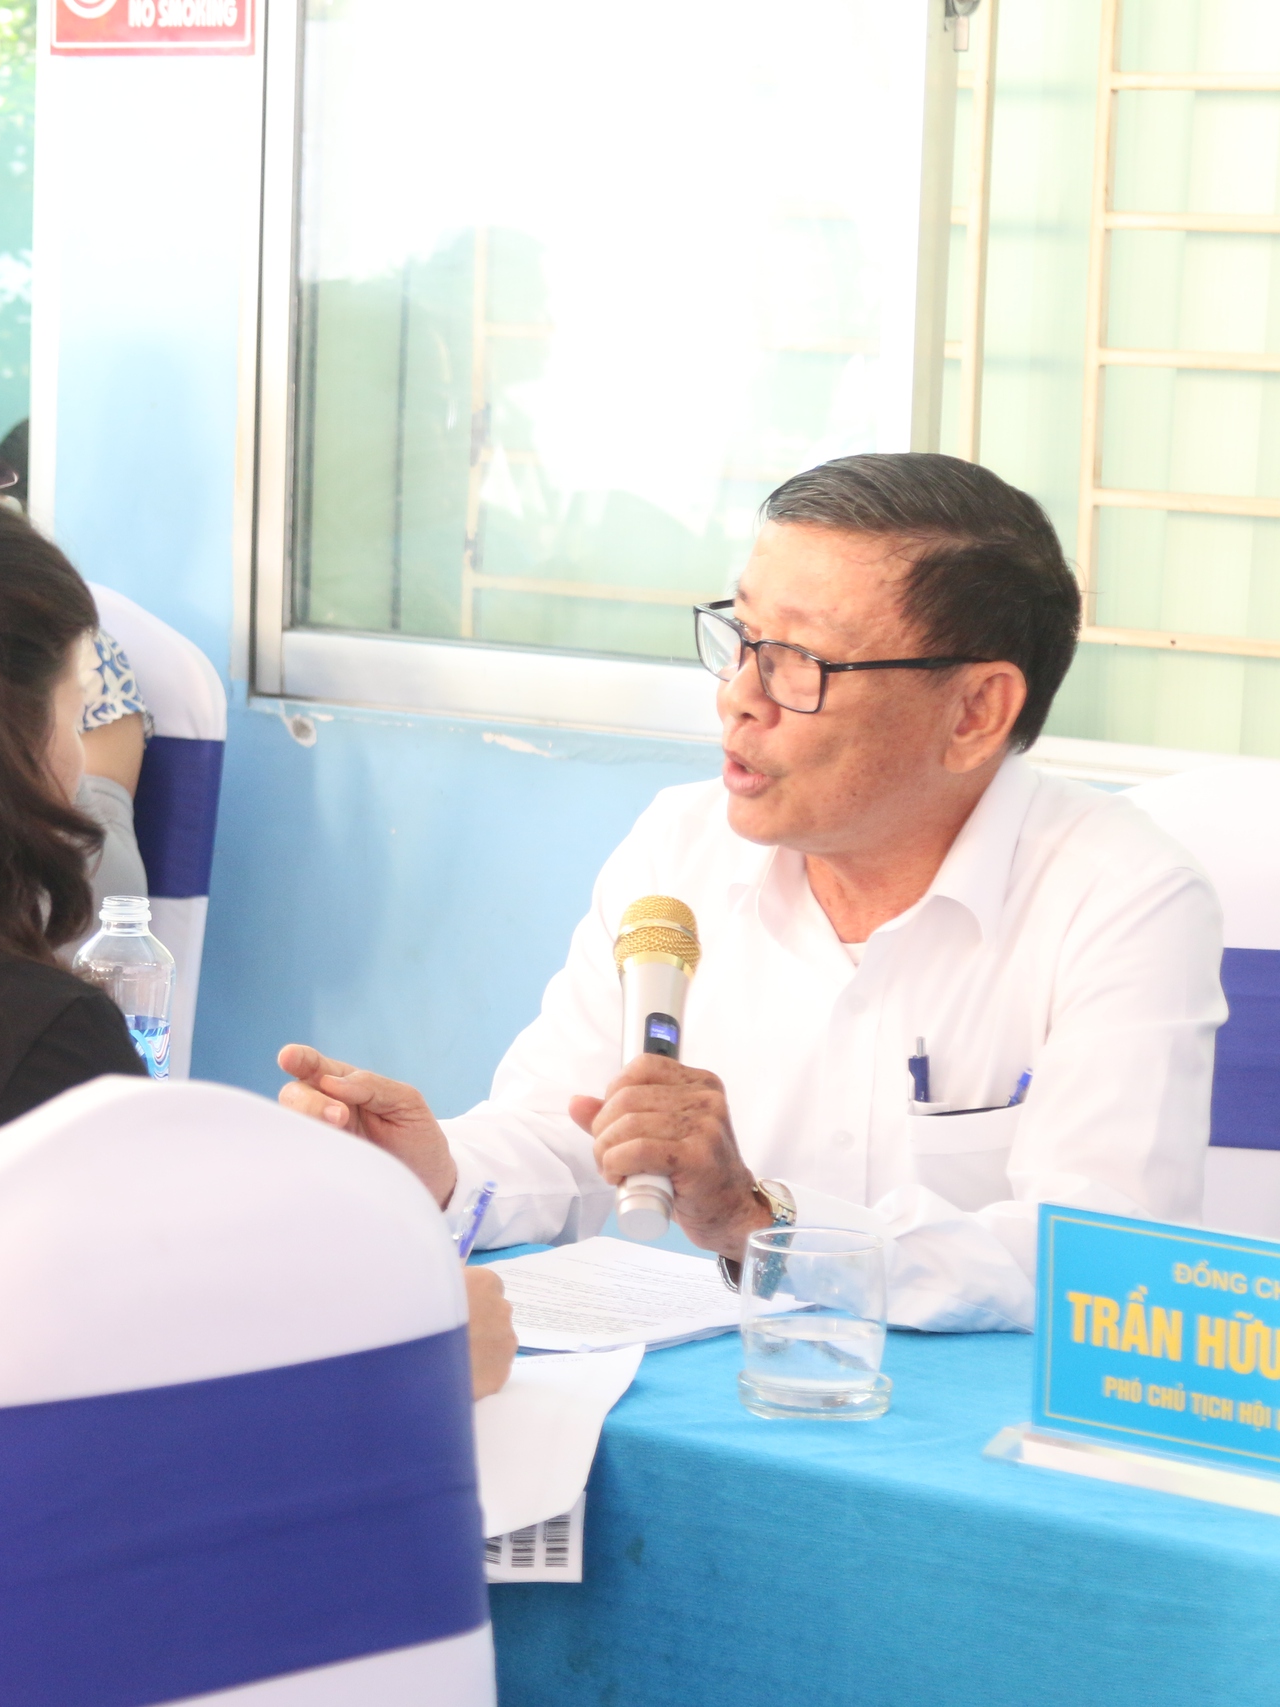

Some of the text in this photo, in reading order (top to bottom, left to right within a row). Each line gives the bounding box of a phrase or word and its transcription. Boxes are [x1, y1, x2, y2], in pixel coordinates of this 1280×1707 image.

[128, 0, 238, 27] NO SMOKING
[1174, 1259, 1248, 1295] ĐỒNG
[1067, 1285, 1183, 1362] TRẦN
[1104, 1376, 1143, 1404] PHÓ
[1147, 1382, 1186, 1412] CHỦ
[1191, 1391, 1234, 1422] TỊCH
[1239, 1400, 1272, 1432] HỘI
